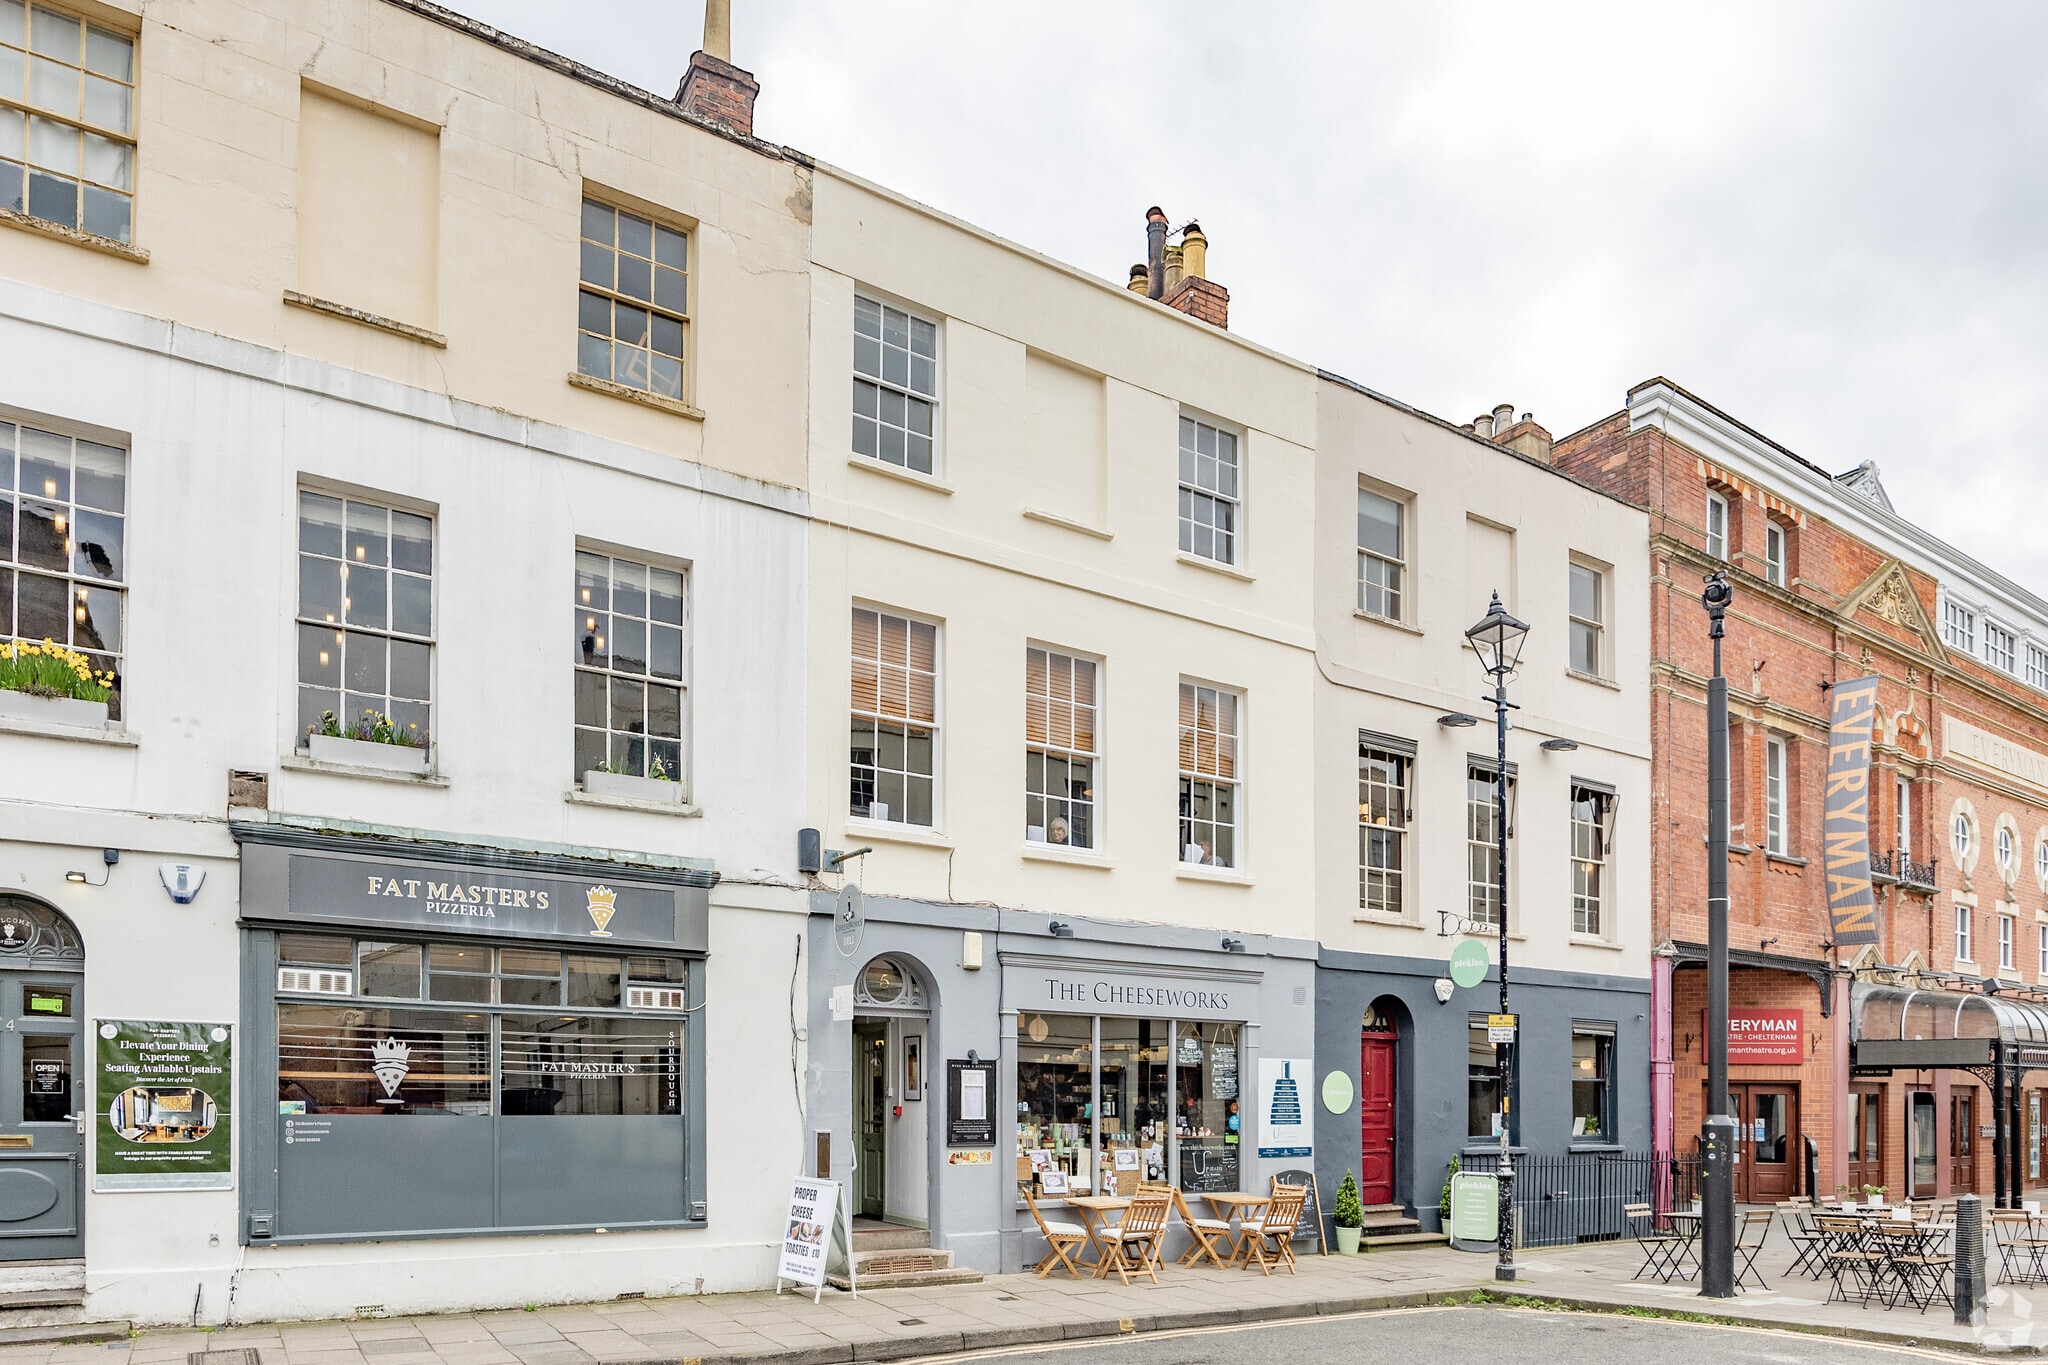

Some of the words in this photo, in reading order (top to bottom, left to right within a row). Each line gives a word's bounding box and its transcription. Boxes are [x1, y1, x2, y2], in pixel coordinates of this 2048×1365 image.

[1827, 686, 1876, 934] EVERYMAN
[368, 876, 421, 898] FAT
[427, 881, 549, 909] MASTER'S
[426, 902, 495, 917] PIZZERIA
[0, 917, 31, 927] LCOME
[843, 935, 855, 946] DELI
[1454, 959, 1486, 969] pickles.
[879, 974, 890, 989] 5
[1045, 979, 1086, 1001] THE
[1093, 982, 1229, 1010] CHEESEWORKS
[6, 1019, 15, 1031] 4
[1727, 1019, 1797, 1031] ERYMAN
[120, 1041, 154, 1050] Elevate
[155, 1042, 178, 1050] Your
[179, 1042, 209, 1053] Dining
[1728, 1047, 1797, 1055] mantheatre.org.uk
[139, 1052, 190, 1063] Experience
[105, 1063, 140, 1074] Seating
[141, 1064, 184, 1073] Available
[185, 1065, 222, 1075] Upstairs
[541, 1062, 567, 1072] FAT
[571, 1063, 635, 1073] MASTER'S
[570, 1072, 607, 1080] PIZZERIA
[1460, 1181, 1494, 1190] pickles.
[793, 1187, 817, 1201] PROPER
[791, 1205, 814, 1220] CHEESE
[785, 1242, 809, 1257] TOASTIES
[811, 1249, 820, 1259] £10
